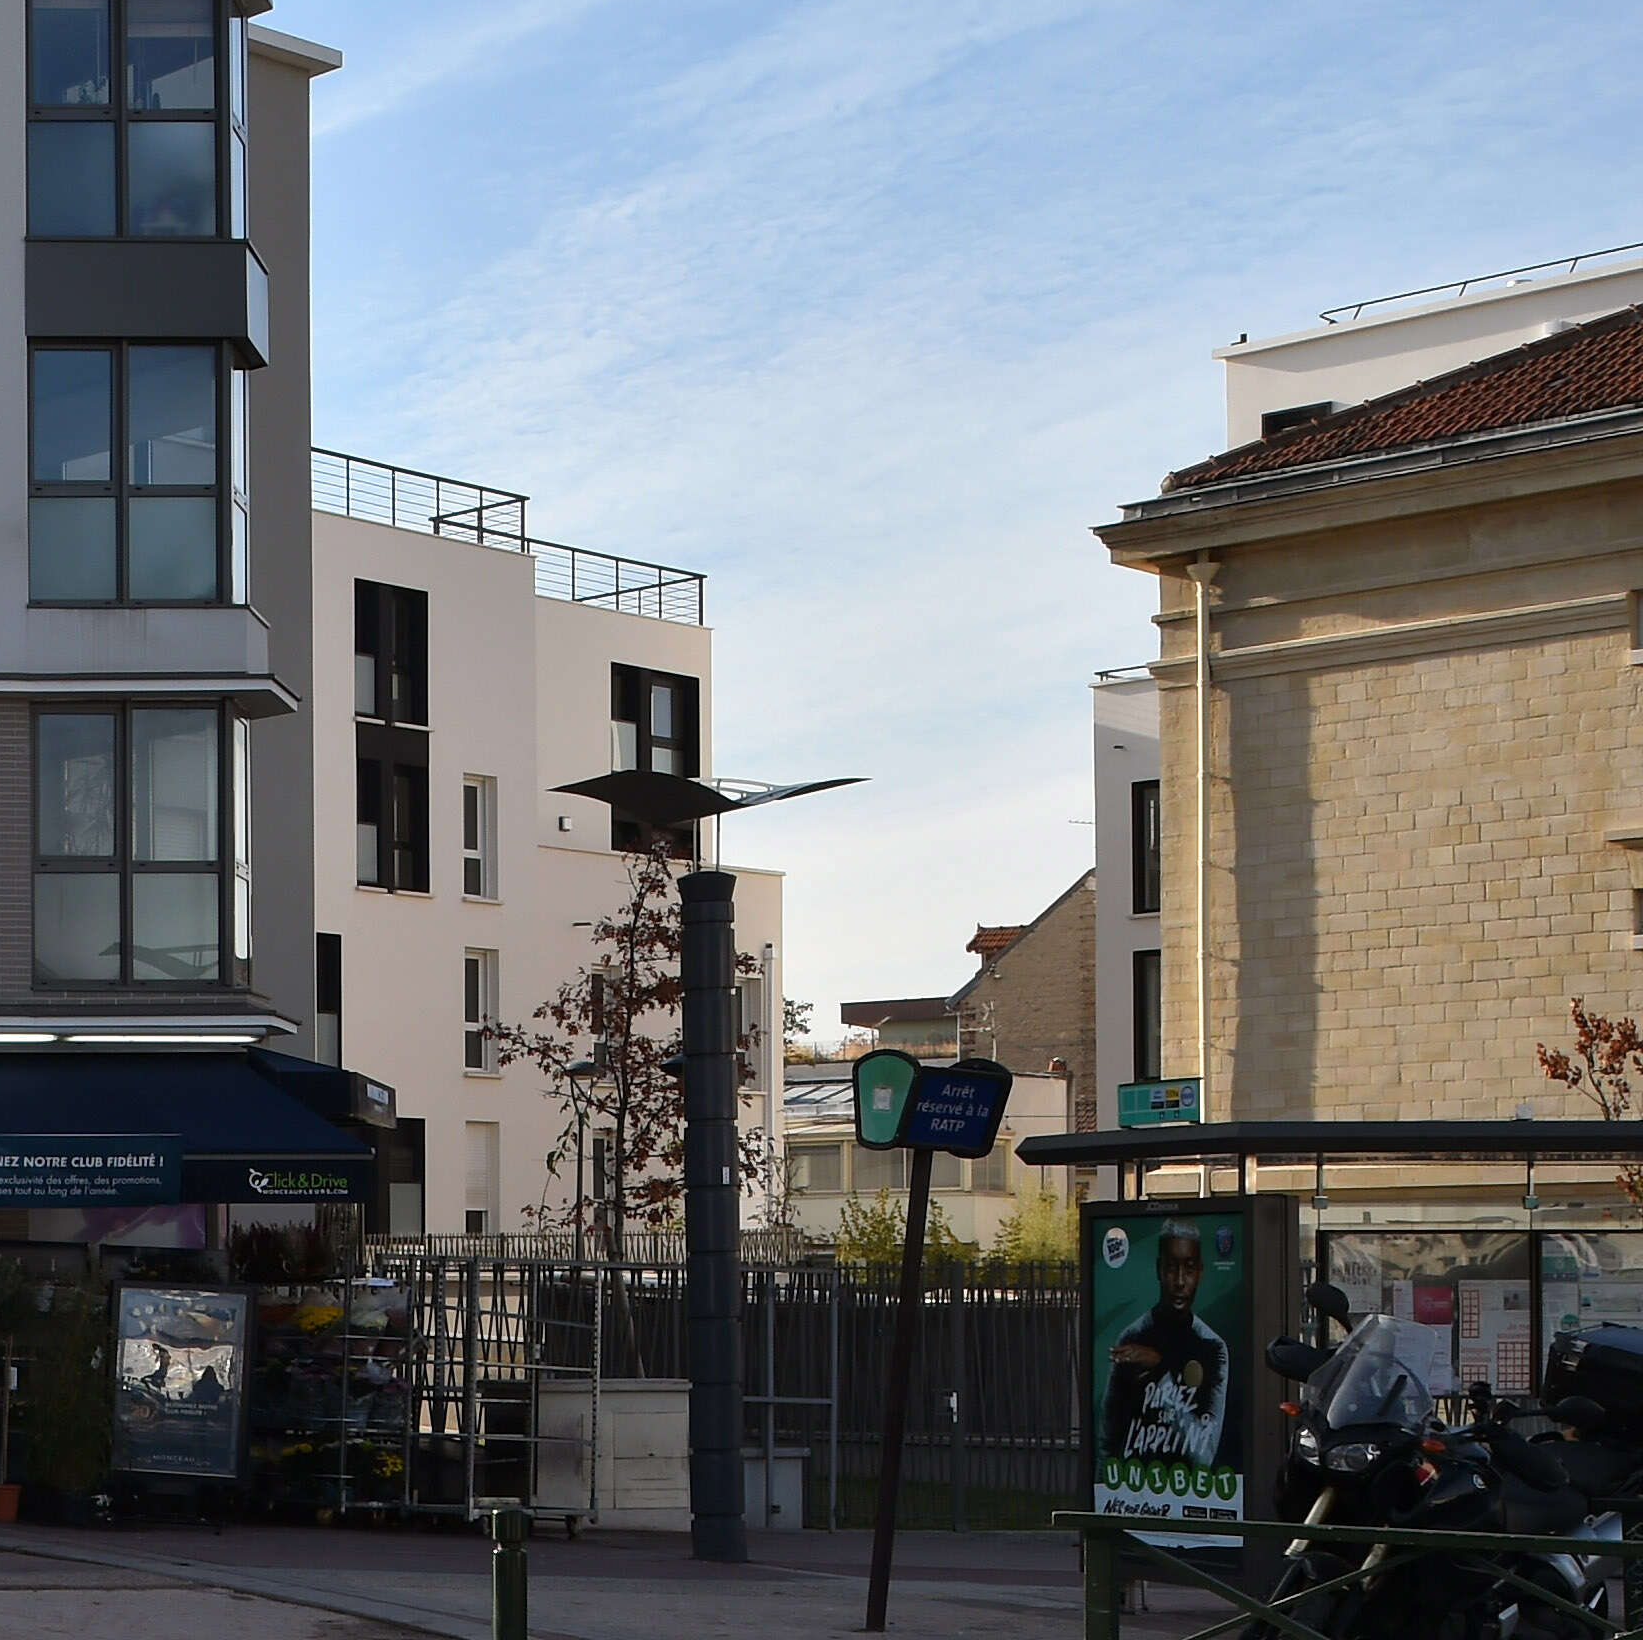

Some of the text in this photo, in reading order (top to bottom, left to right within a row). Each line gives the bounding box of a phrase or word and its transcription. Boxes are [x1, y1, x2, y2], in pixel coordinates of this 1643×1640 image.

[941, 1083, 975, 1099] Arrêt
[916, 1100, 990, 1118] réservé à la
[930, 1117, 965, 1133] RATP
[23, 1156, 68, 1168] NOTRE
[71, 1156, 103, 1168] CLUB
[106, 1153, 156, 1168] FIDÉLITÉ
[46, 1175, 62, 1185] des
[94, 1175, 110, 1185] des
[265, 1171, 297, 1188] Click
[311, 1172, 348, 1188] Drive
[47, 1186, 68, 1197] long
[69, 1186, 82, 1195] de
[1106, 1463, 1232, 1495] UNIBET
